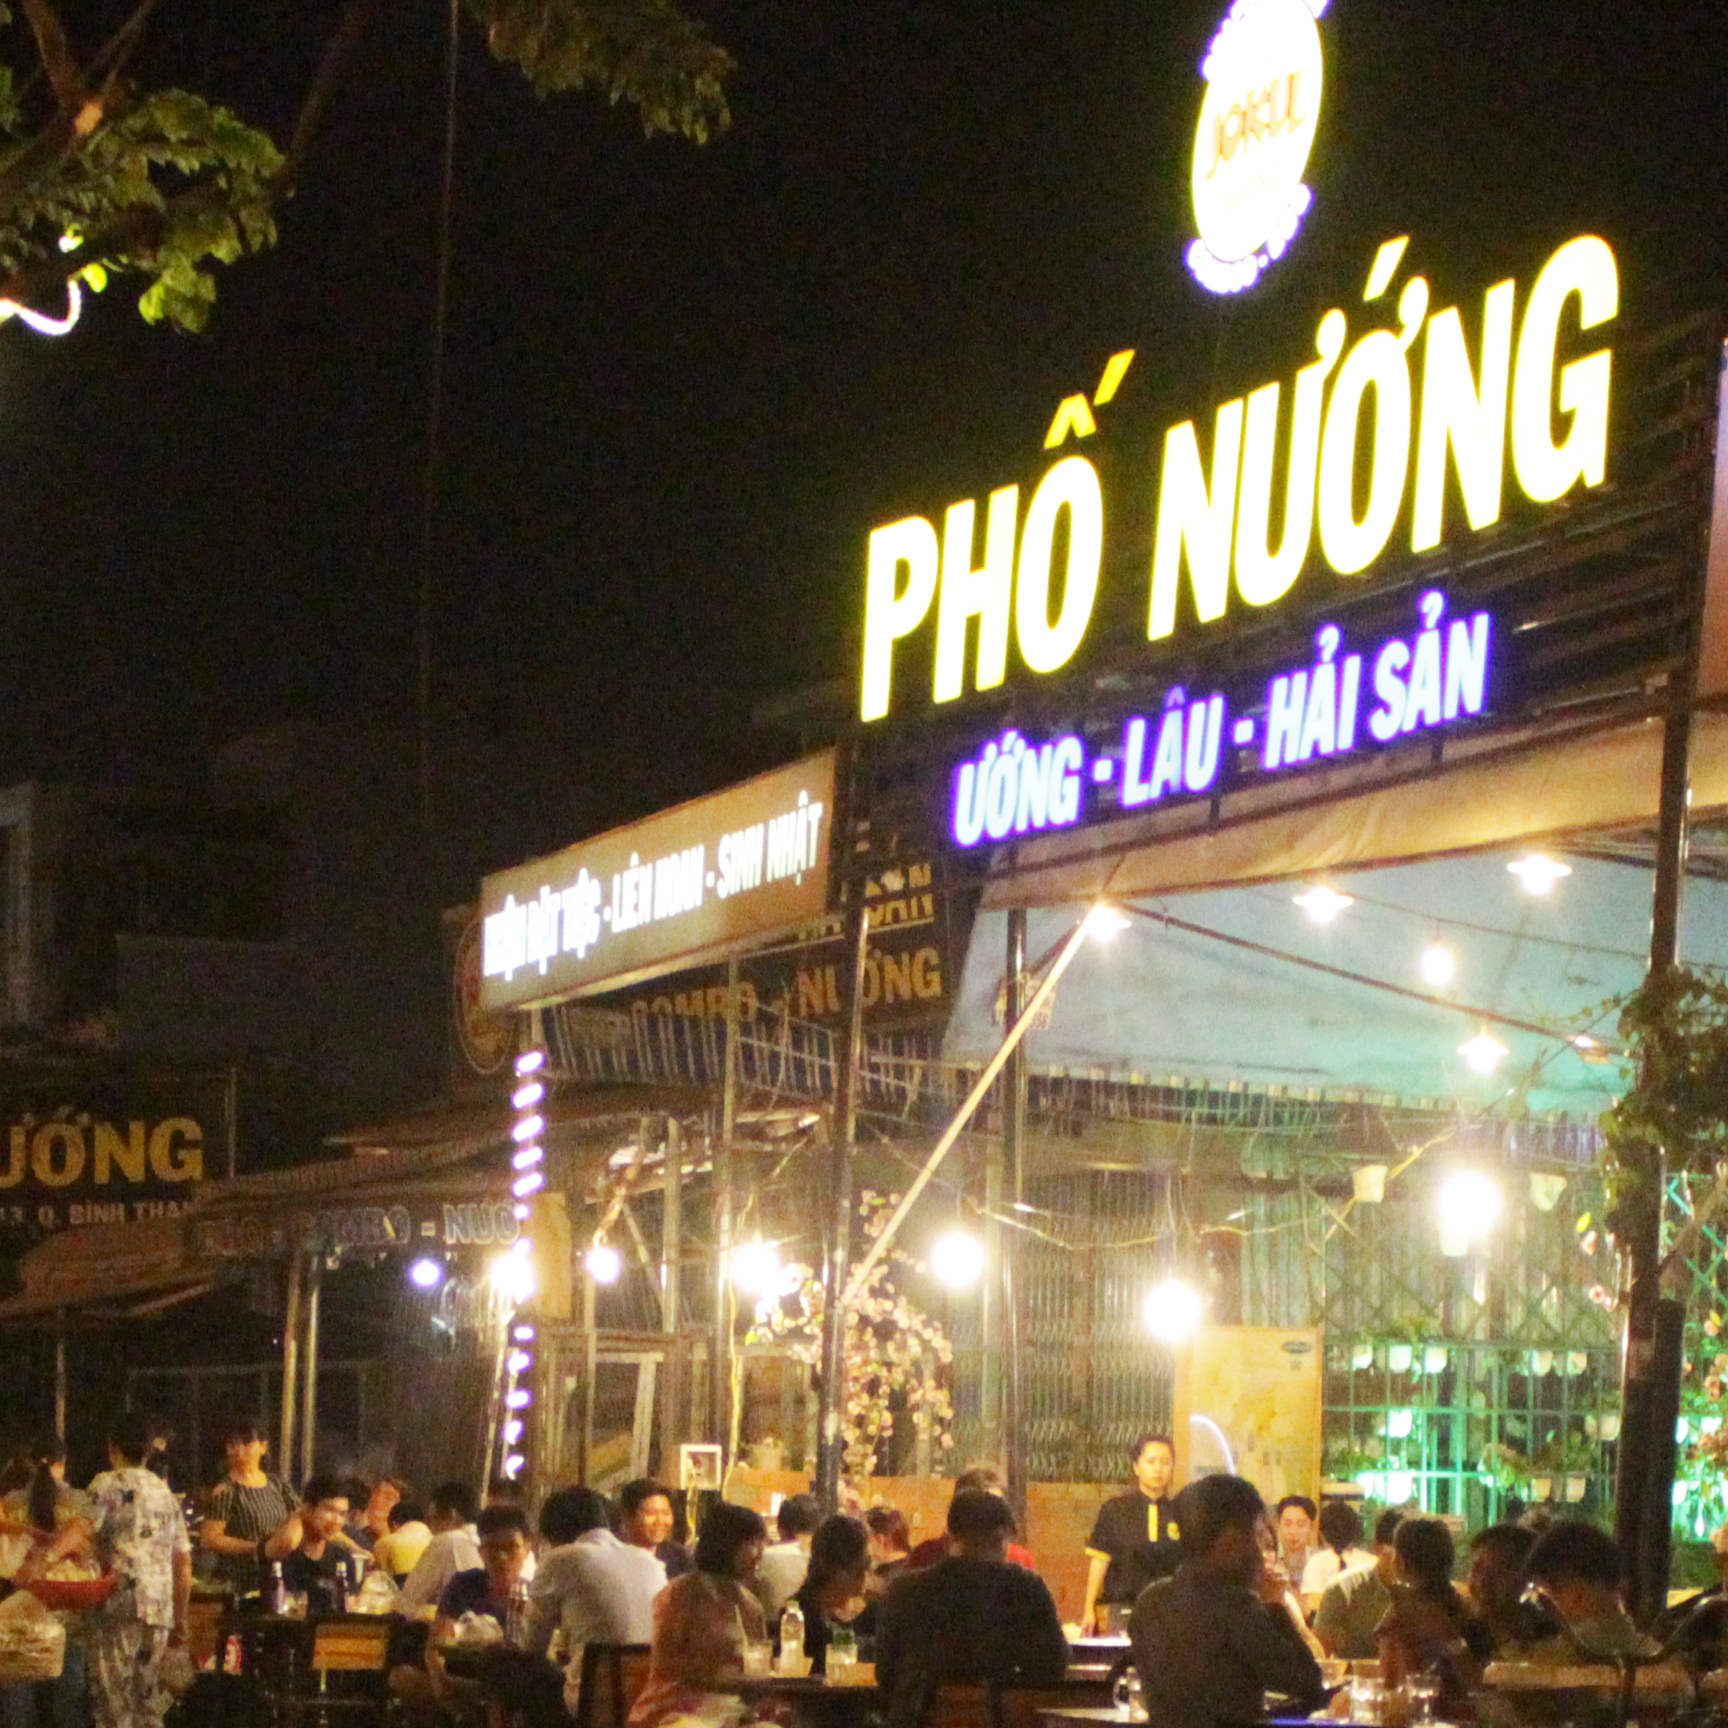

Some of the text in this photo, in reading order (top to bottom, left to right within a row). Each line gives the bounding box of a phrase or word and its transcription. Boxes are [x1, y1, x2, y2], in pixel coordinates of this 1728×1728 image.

[859, 234, 1620, 723] PHỐ NƯỚNG
[1260, 622, 1363, 771] HẢI
[1367, 588, 1493, 742] SẢN
